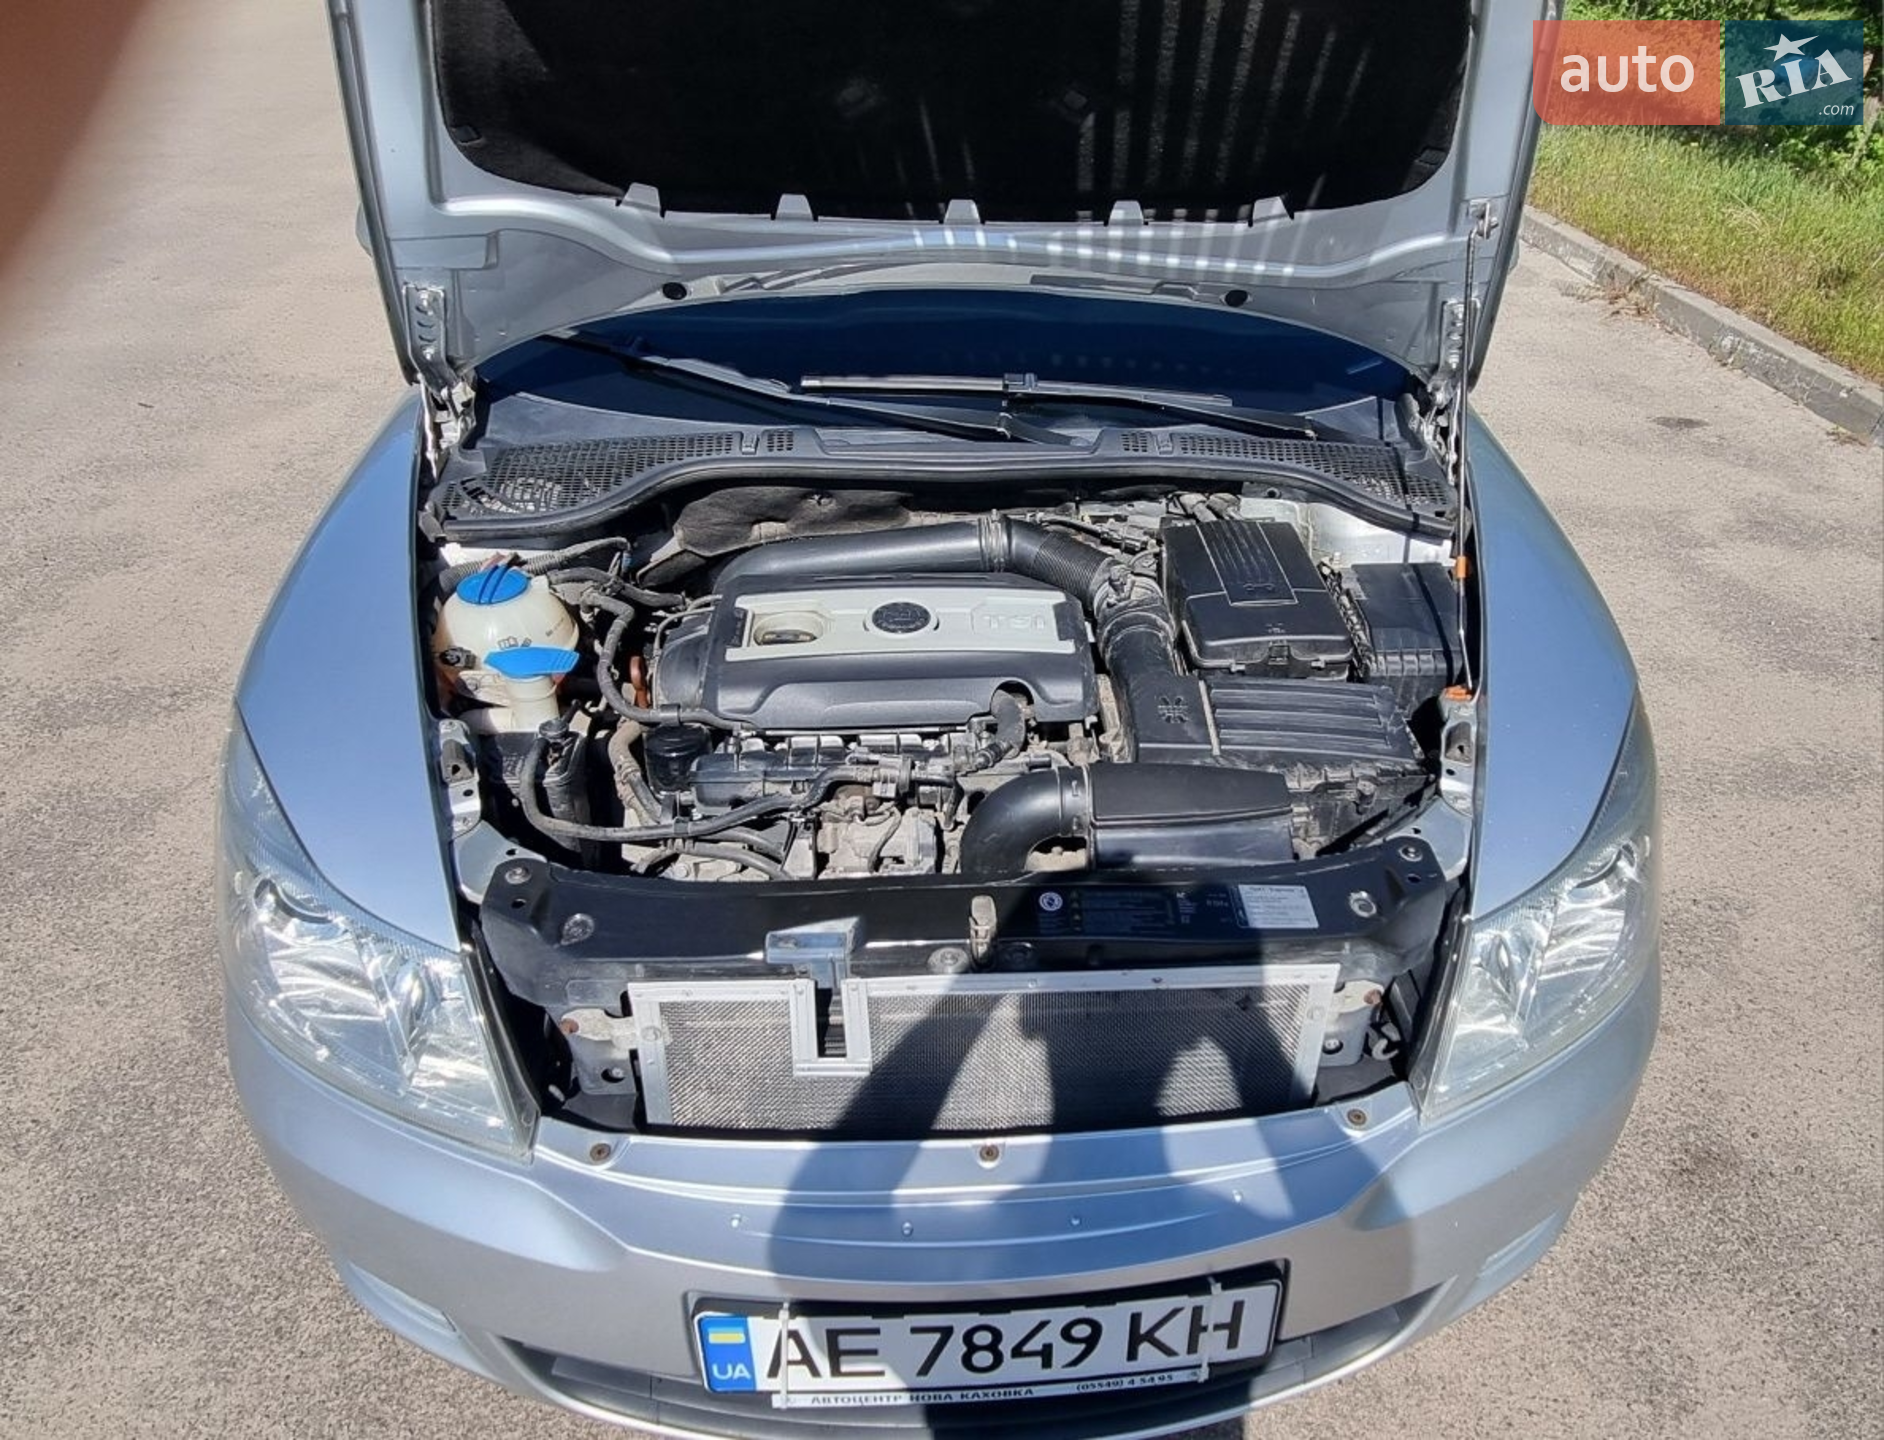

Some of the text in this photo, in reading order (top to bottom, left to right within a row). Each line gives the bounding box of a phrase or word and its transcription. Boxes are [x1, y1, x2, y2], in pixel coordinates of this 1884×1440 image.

[767, 1300, 1245, 1378] AE 7849 KH
[712, 1362, 752, 1381] UA
[960, 1388, 1034, 1399] КАХОВКА
